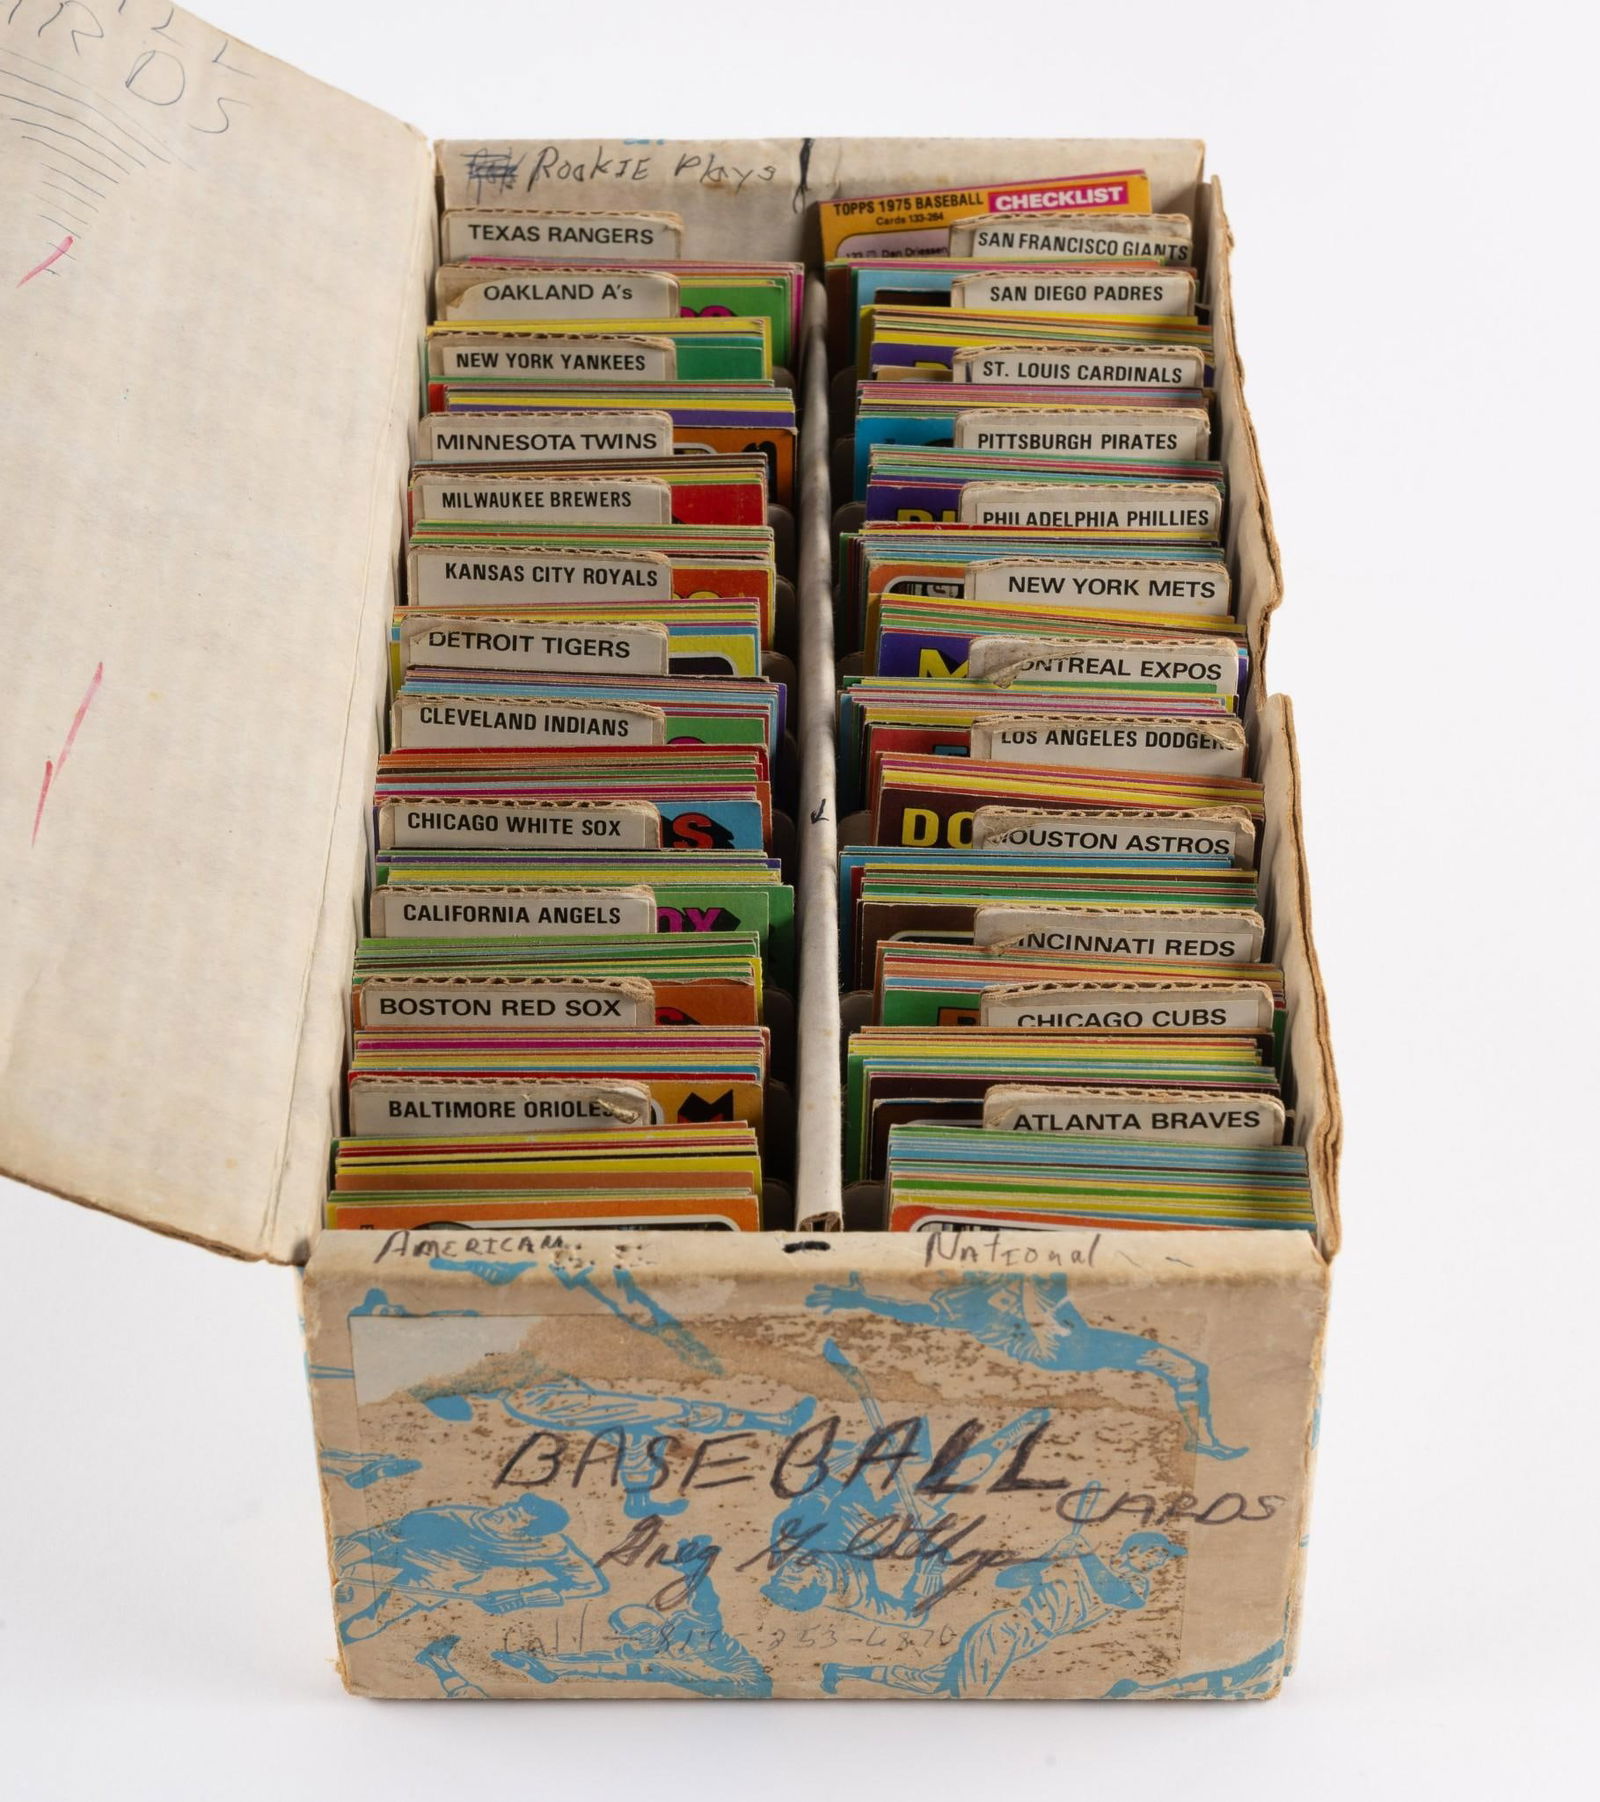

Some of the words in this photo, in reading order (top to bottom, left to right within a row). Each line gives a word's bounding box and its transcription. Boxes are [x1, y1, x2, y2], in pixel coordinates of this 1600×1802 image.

[833, 202, 875, 216] TOPPS
[880, 198, 911, 213] 1975
[915, 192, 984, 210] BASEBALL
[994, 186, 1124, 212] CHECKLIST
[876, 215, 906, 226] Cards
[468, 225, 540, 242] TEXAS
[549, 227, 654, 244] RANGERS
[978, 232, 1014, 248] SAN
[1018, 233, 1118, 256] FRANCISCO
[1123, 241, 1189, 261] GIANTS
[484, 284, 594, 301] OAKLAND
[602, 284, 633, 300] A's
[990, 286, 1026, 302] SAN
[1035, 286, 1087, 301] DIEGO
[1094, 286, 1163, 301] PADRES
[456, 352, 498, 369] NEW
[507, 353, 554, 370] YORK
[563, 355, 646, 371] YANKEES
[983, 361, 1009, 378] ST.
[1017, 362, 1071, 380] LOUIS
[1077, 364, 1183, 384] CARDINALS
[437, 433, 575, 450] MINNESOTA
[580, 433, 657, 450] TWINS
[978, 433, 1092, 450] PITTSBURGH
[1100, 433, 1178, 450] PIRATES
[442, 492, 545, 508] MILWAUKEE
[550, 491, 632, 508] BREWERS
[983, 510, 1119, 528] PHILADELPHIA
[1127, 509, 1209, 527] PHILLIES
[445, 562, 525, 582] KANSAS
[532, 566, 575, 585] CITY
[583, 568, 658, 587] ROYALS
[1008, 576, 1065, 595] NEW
[1072, 577, 1139, 597] YORK
[1149, 579, 1216, 599] METS
[428, 631, 535, 653] DETROIT
[542, 637, 631, 659] TIGERS
[1020, 657, 1131, 676] NTREAL
[1141, 660, 1222, 681] EXPOS
[420, 706, 537, 731] CLEVELAND
[544, 714, 629, 737] INDIANS
[1002, 730, 1037, 745] LOS
[1046, 730, 1137, 748] ANGELES
[407, 811, 499, 832] CHICAGO
[506, 816, 574, 835] WHITE
[581, 819, 621, 836] SOX
[1002, 830, 1117, 850] OUSTON
[1126, 835, 1230, 855] ASTROS
[403, 904, 530, 923] CALIFORNIA
[538, 906, 621, 925] ANGELS
[1018, 933, 1154, 954] INCINNATI
[1165, 939, 1236, 957] REDS
[380, 998, 492, 1016] BOSTON
[501, 999, 557, 1017] RED
[565, 999, 622, 1017] SOX
[1017, 1011, 1143, 1027] CHICAGO
[1152, 1008, 1227, 1026] CUBS
[388, 1100, 516, 1119] BALTIMORE
[1013, 1113, 1141, 1131] ATLANTA
[1152, 1111, 1260, 1130] BRAVES
[492, 1416, 1071, 1499] BASEBALL
[1056, 1487, 1284, 1526] CARDS
